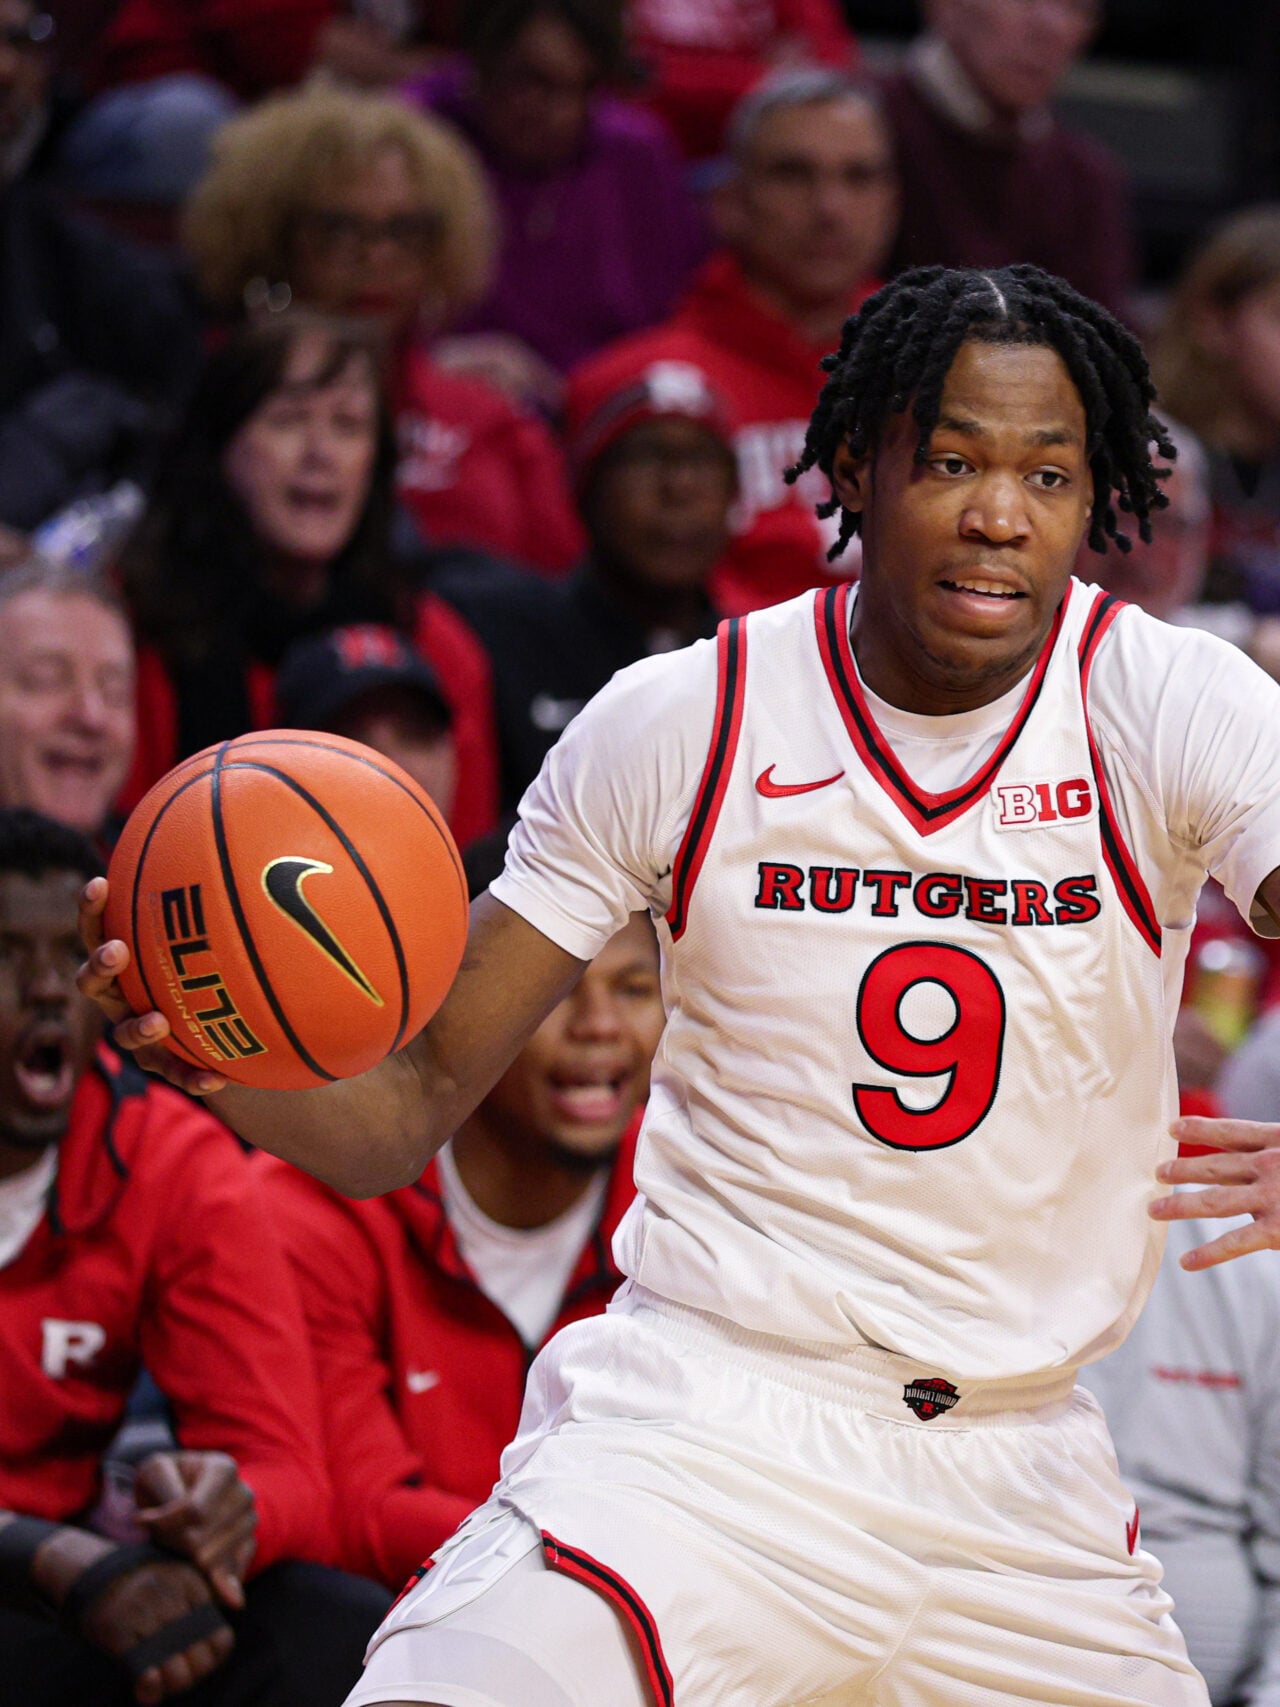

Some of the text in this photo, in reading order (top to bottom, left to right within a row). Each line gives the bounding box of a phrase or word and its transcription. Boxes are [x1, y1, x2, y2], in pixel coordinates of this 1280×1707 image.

[161, 883, 268, 1060] ELITE
[754, 861, 1102, 926] RUTGERS
[852, 940, 1006, 1152] 9
